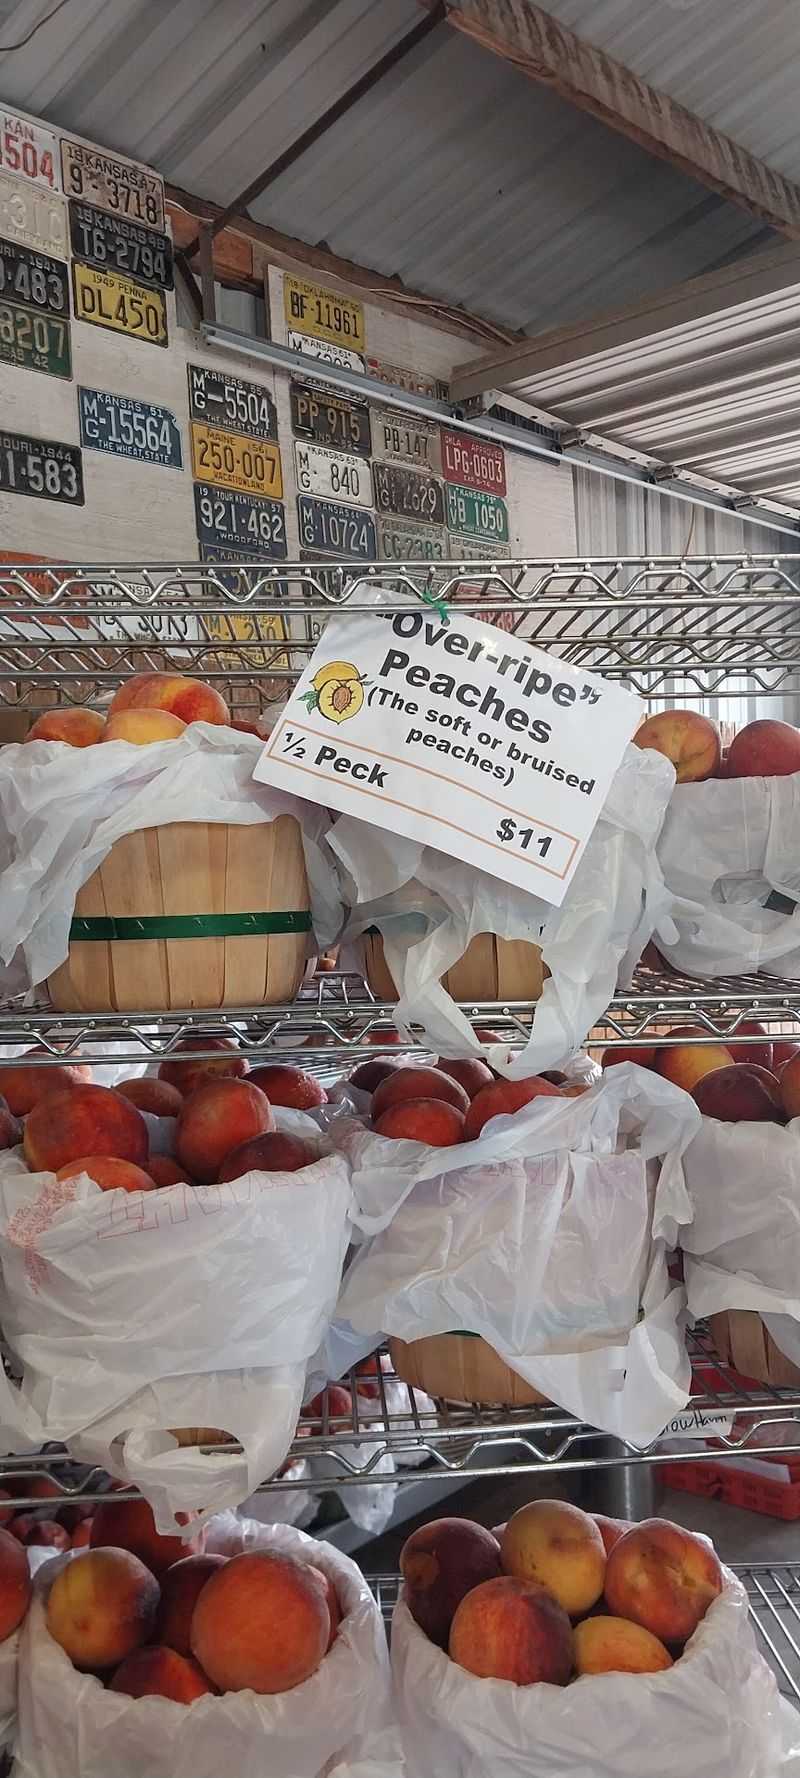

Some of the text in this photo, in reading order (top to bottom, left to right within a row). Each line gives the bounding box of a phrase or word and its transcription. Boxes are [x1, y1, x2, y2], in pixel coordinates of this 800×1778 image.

[4, 118, 34, 141] KAN
[0, 132, 54, 187] 504
[85, 153, 137, 186] KANSAS
[95, 212, 147, 245] KANSAS
[80, 222, 166, 283] T6-2794
[92, 273, 115, 288] 1949
[80, 284, 159, 337] DL450
[290, 290, 360, 339] BF-11961
[0, 306, 65, 358] 8207
[204, 370, 243, 389] KANSAS
[96, 393, 142, 412] KANSAS
[328, 407, 361, 442] 915
[311, 446, 345, 463] KANSAS
[330, 462, 360, 497] 840
[459, 487, 486, 502] KANSAS
[321, 513, 369, 553] 10724
[475, 501, 504, 533] 1050
[379, 648, 552, 744] Peaches
[366, 686, 595, 795] (The soft or bruised
[405, 726, 515, 787] peaches)
[314, 745, 390, 788] Peck
[496, 818, 553, 859] $11
